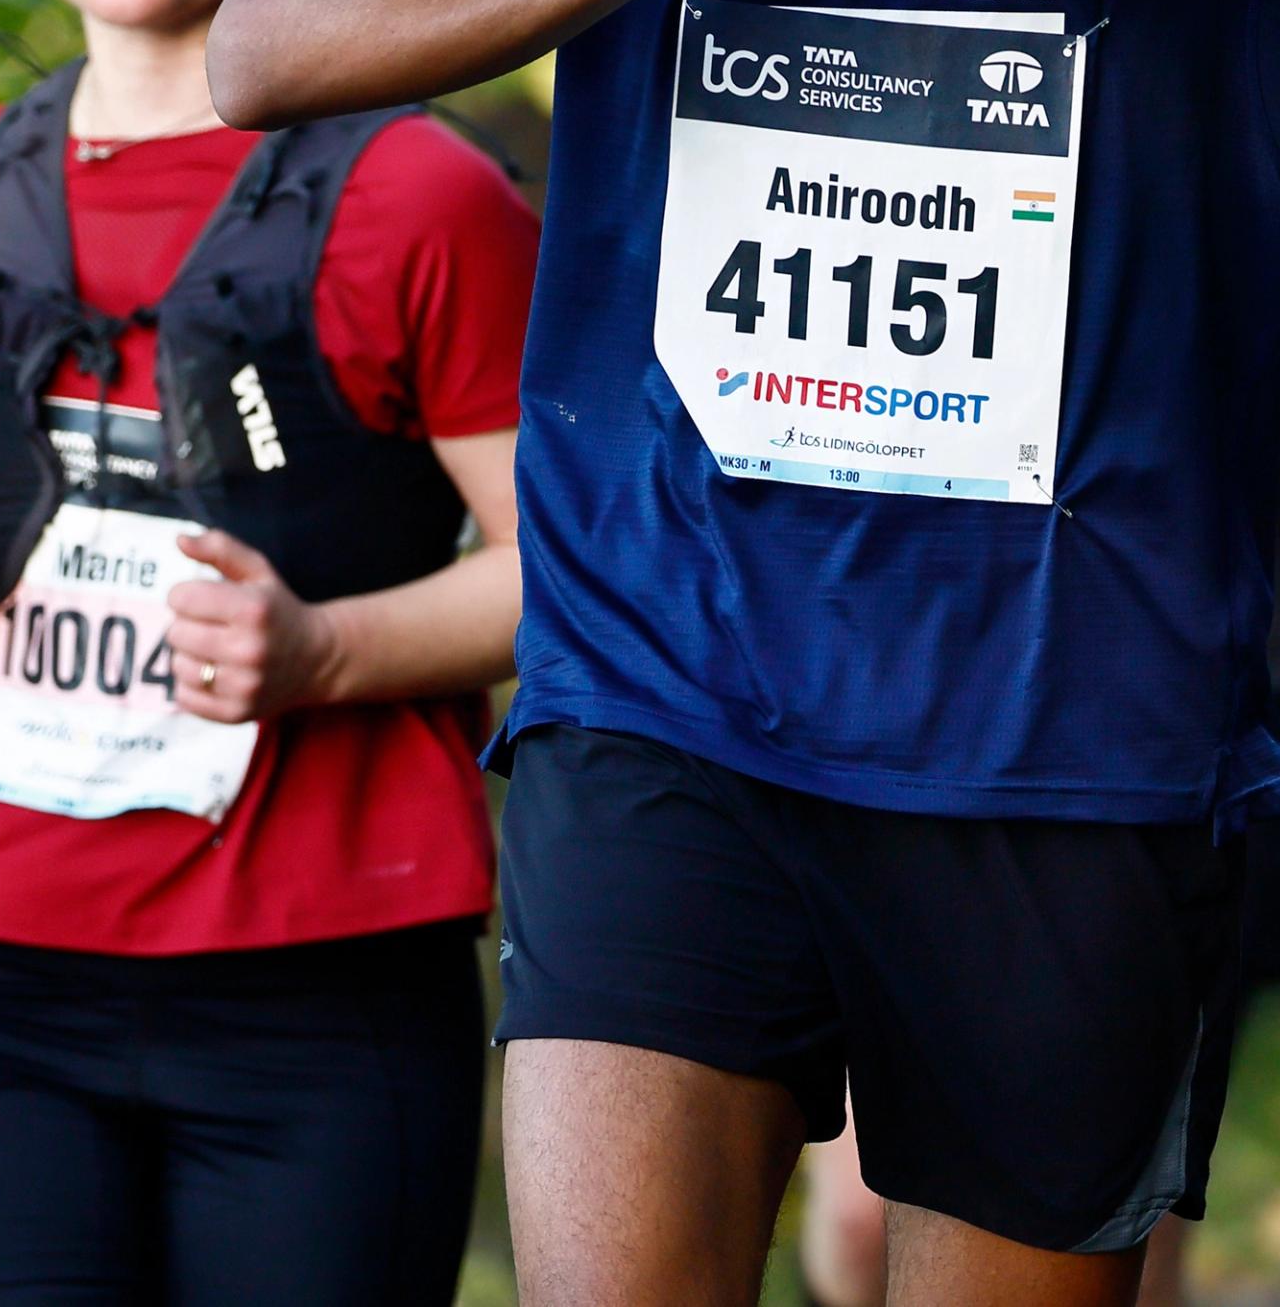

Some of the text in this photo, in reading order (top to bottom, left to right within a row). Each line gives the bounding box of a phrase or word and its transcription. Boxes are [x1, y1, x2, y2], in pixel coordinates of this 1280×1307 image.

[701, 33, 790, 101] tcs
[803, 44, 858, 68] TATA
[800, 67, 935, 97] CONSULTANCY
[799, 88, 884, 113] SERVICES
[966, 98, 1050, 128] TATA
[765, 165, 977, 233] Aniroodh
[705, 238, 1000, 360] 41151
[753, 371, 991, 425] INTERSPORT
[799, 431, 926, 459] tcs LIDINGÖLOPPET
[720, 455, 749, 470] MK30
[760, 459, 772, 472] M
[829, 468, 860, 484] 13:00
[943, 479, 952, 492] 4
[59, 542, 158, 588] Marie
